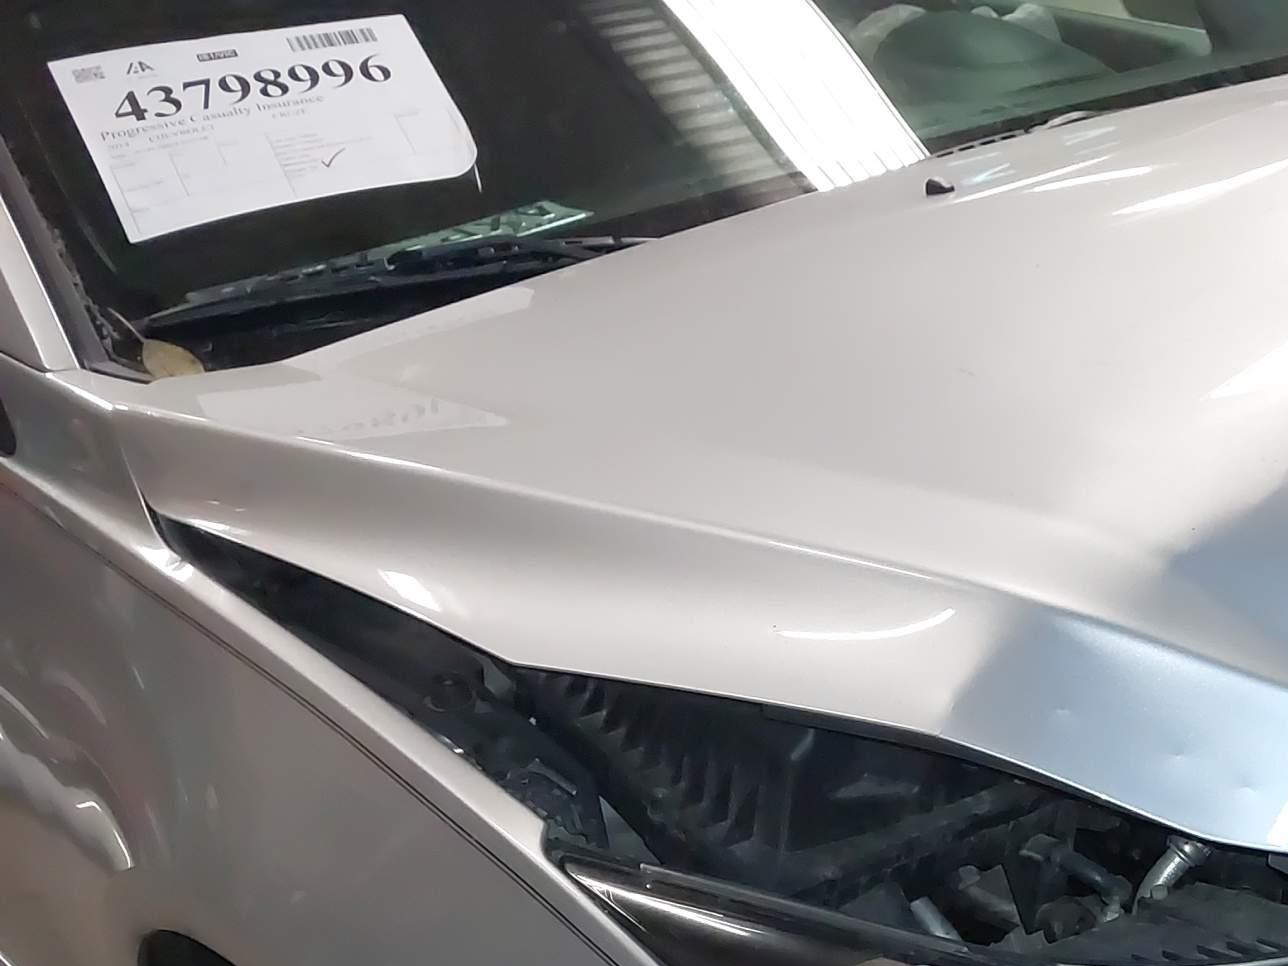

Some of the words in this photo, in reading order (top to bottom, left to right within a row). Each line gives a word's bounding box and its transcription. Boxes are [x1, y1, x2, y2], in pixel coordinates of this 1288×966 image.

[114, 54, 392, 121] 43798996
[100, 118, 188, 142] Progressive
[190, 106, 252, 123] Casualty
[256, 94, 325, 111] Insurance
